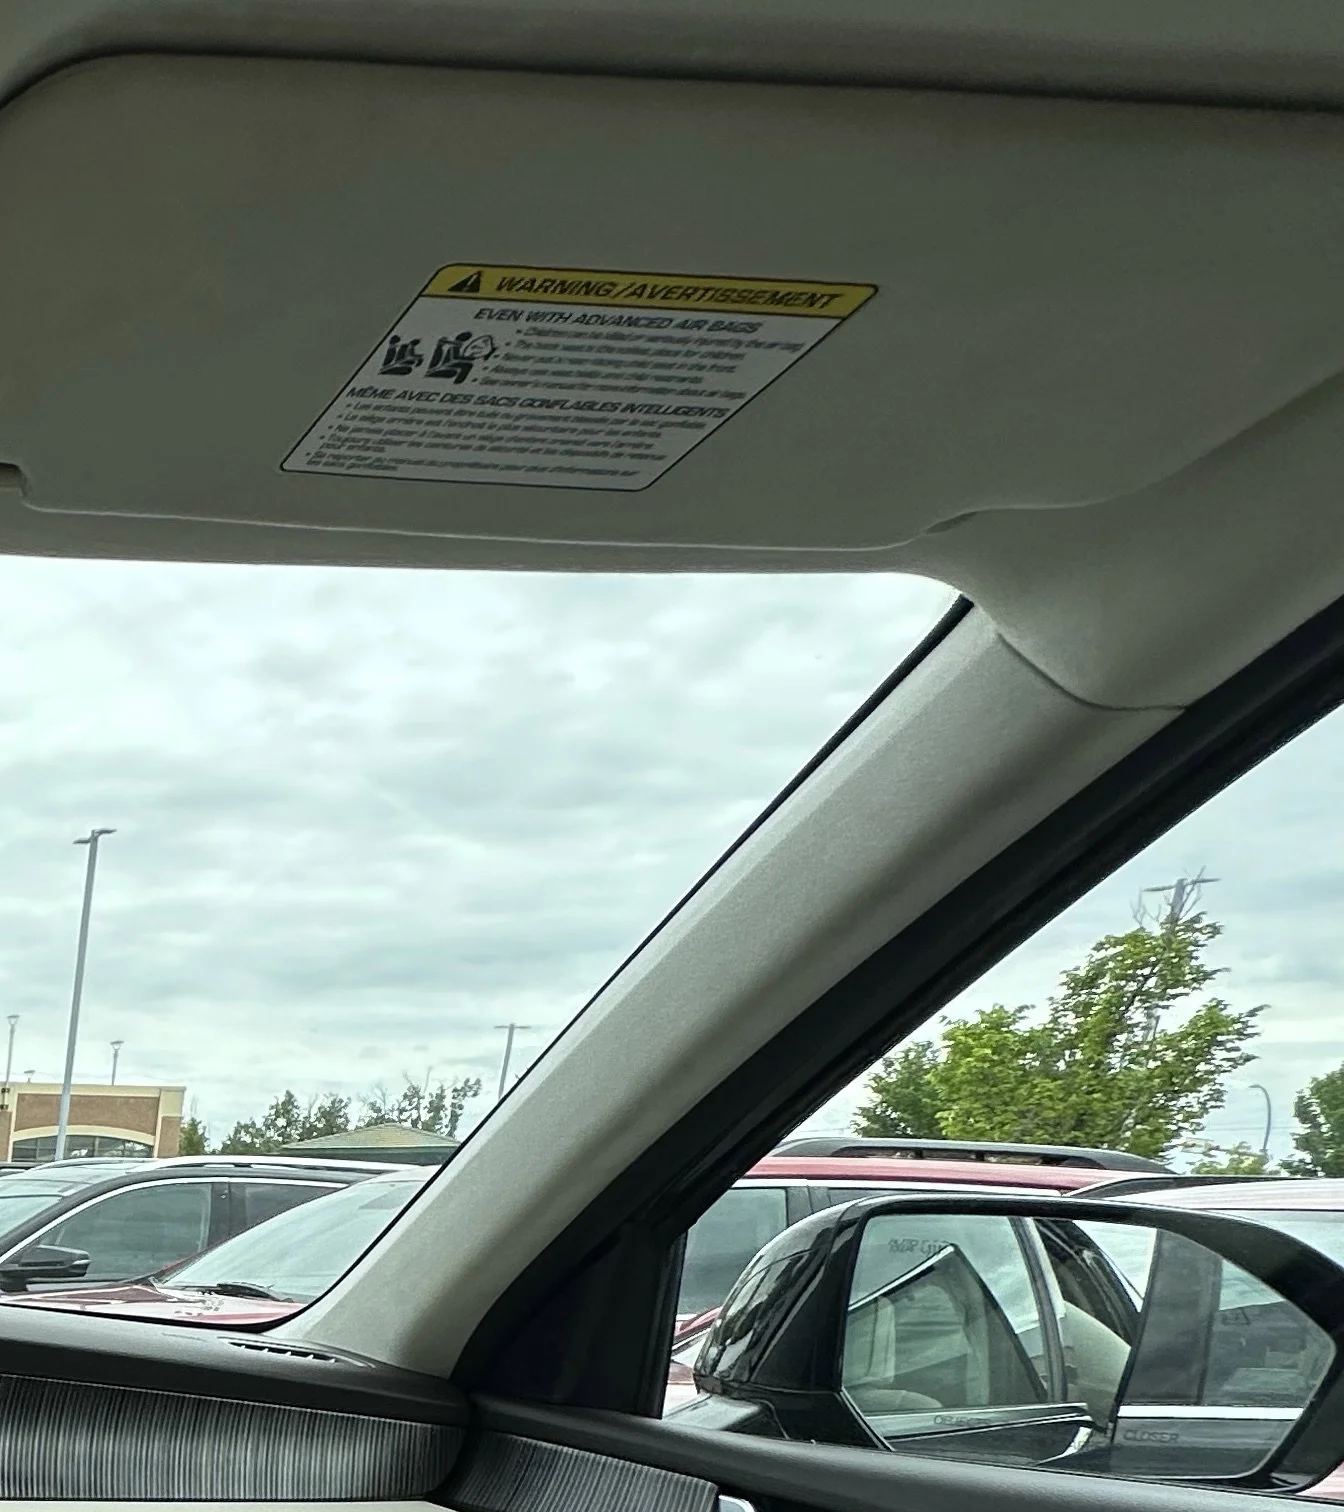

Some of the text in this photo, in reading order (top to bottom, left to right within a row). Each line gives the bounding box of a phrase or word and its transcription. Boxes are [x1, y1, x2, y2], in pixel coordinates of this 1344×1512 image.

[496, 276, 611, 299] WARNING
[474, 308, 764, 335] EVEN WITH ADVANCED AIR BAGS
[395, 388, 439, 402] AVEC
[441, 392, 475, 404] DES
[476, 394, 516, 407] SACS
[622, 401, 730, 419] INTELLIGENTS
[1123, 1430, 1179, 1444] CLOSER
